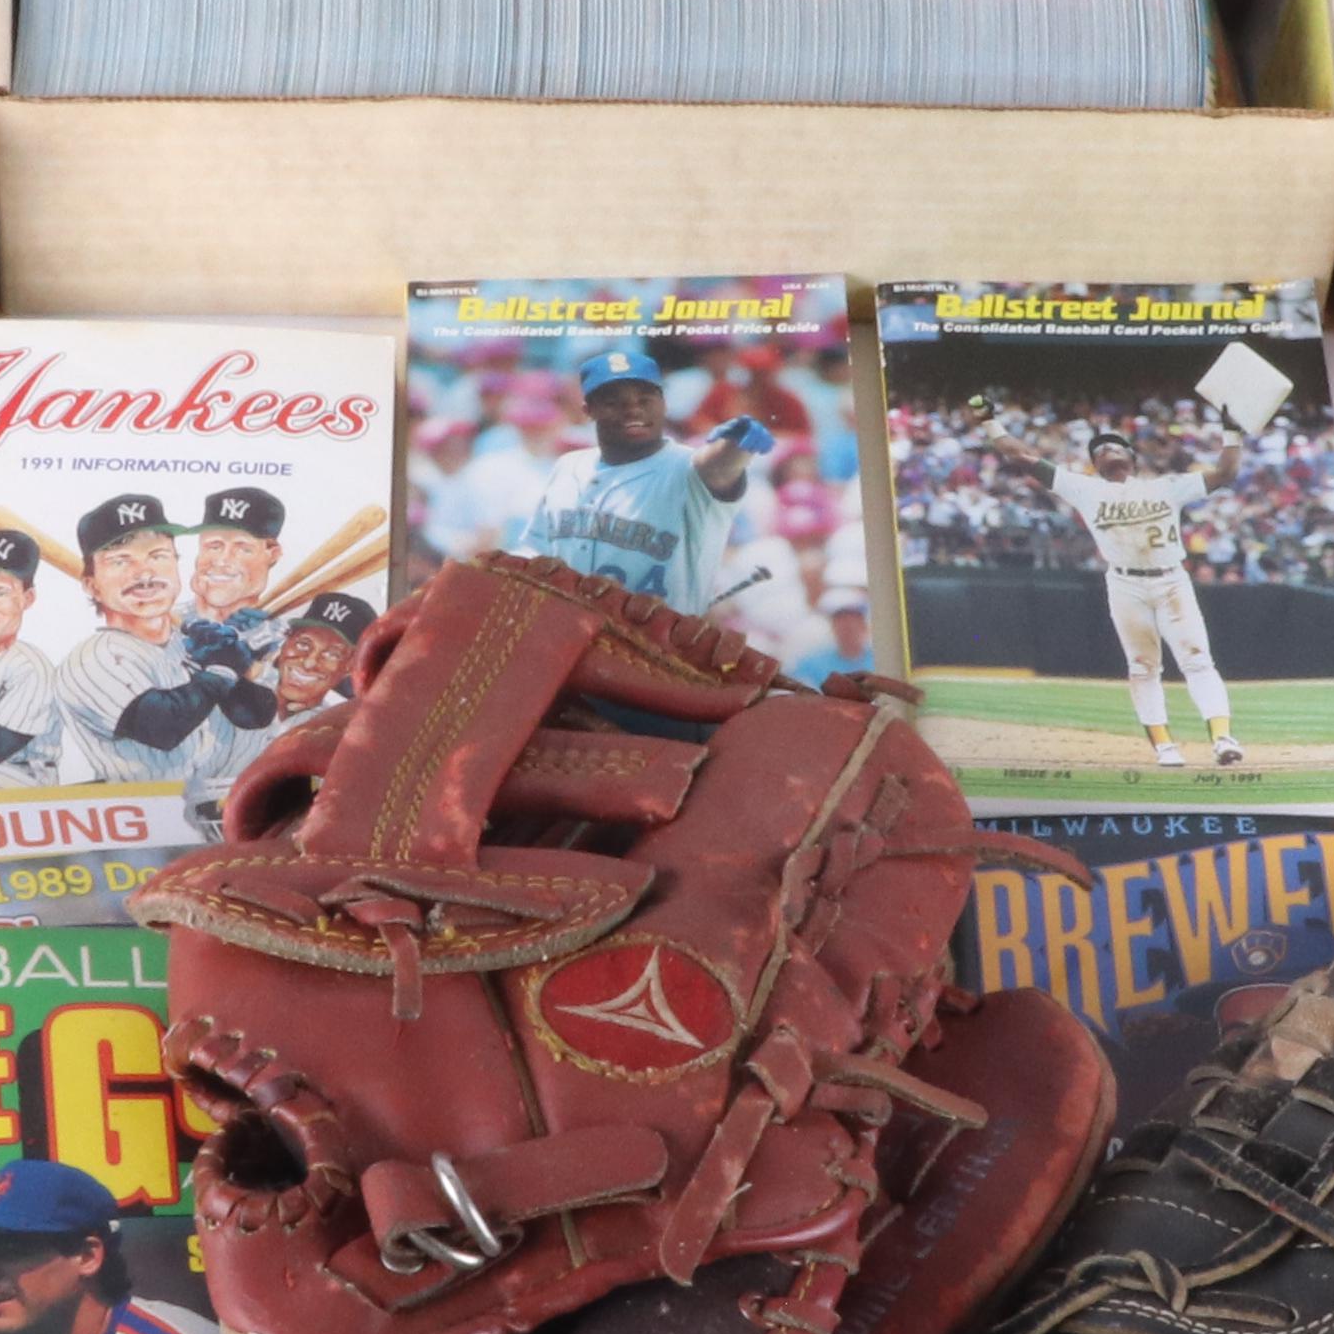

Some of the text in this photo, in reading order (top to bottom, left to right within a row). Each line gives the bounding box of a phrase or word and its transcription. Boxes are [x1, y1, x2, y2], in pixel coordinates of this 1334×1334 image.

[457, 293, 795, 322] Ballstreet Journal
[936, 293, 1266, 321] Ballstreet Journal
[433, 322, 821, 337] The Consolidated Baseball Card Pocket Price Guide
[914, 322, 1294, 336] The Consolidated Baseball Card Pocket Price Guide
[20, 455, 294, 477] 1991 INFORMATION GUIDE
[974, 814, 1258, 838] MILWAUKEE
